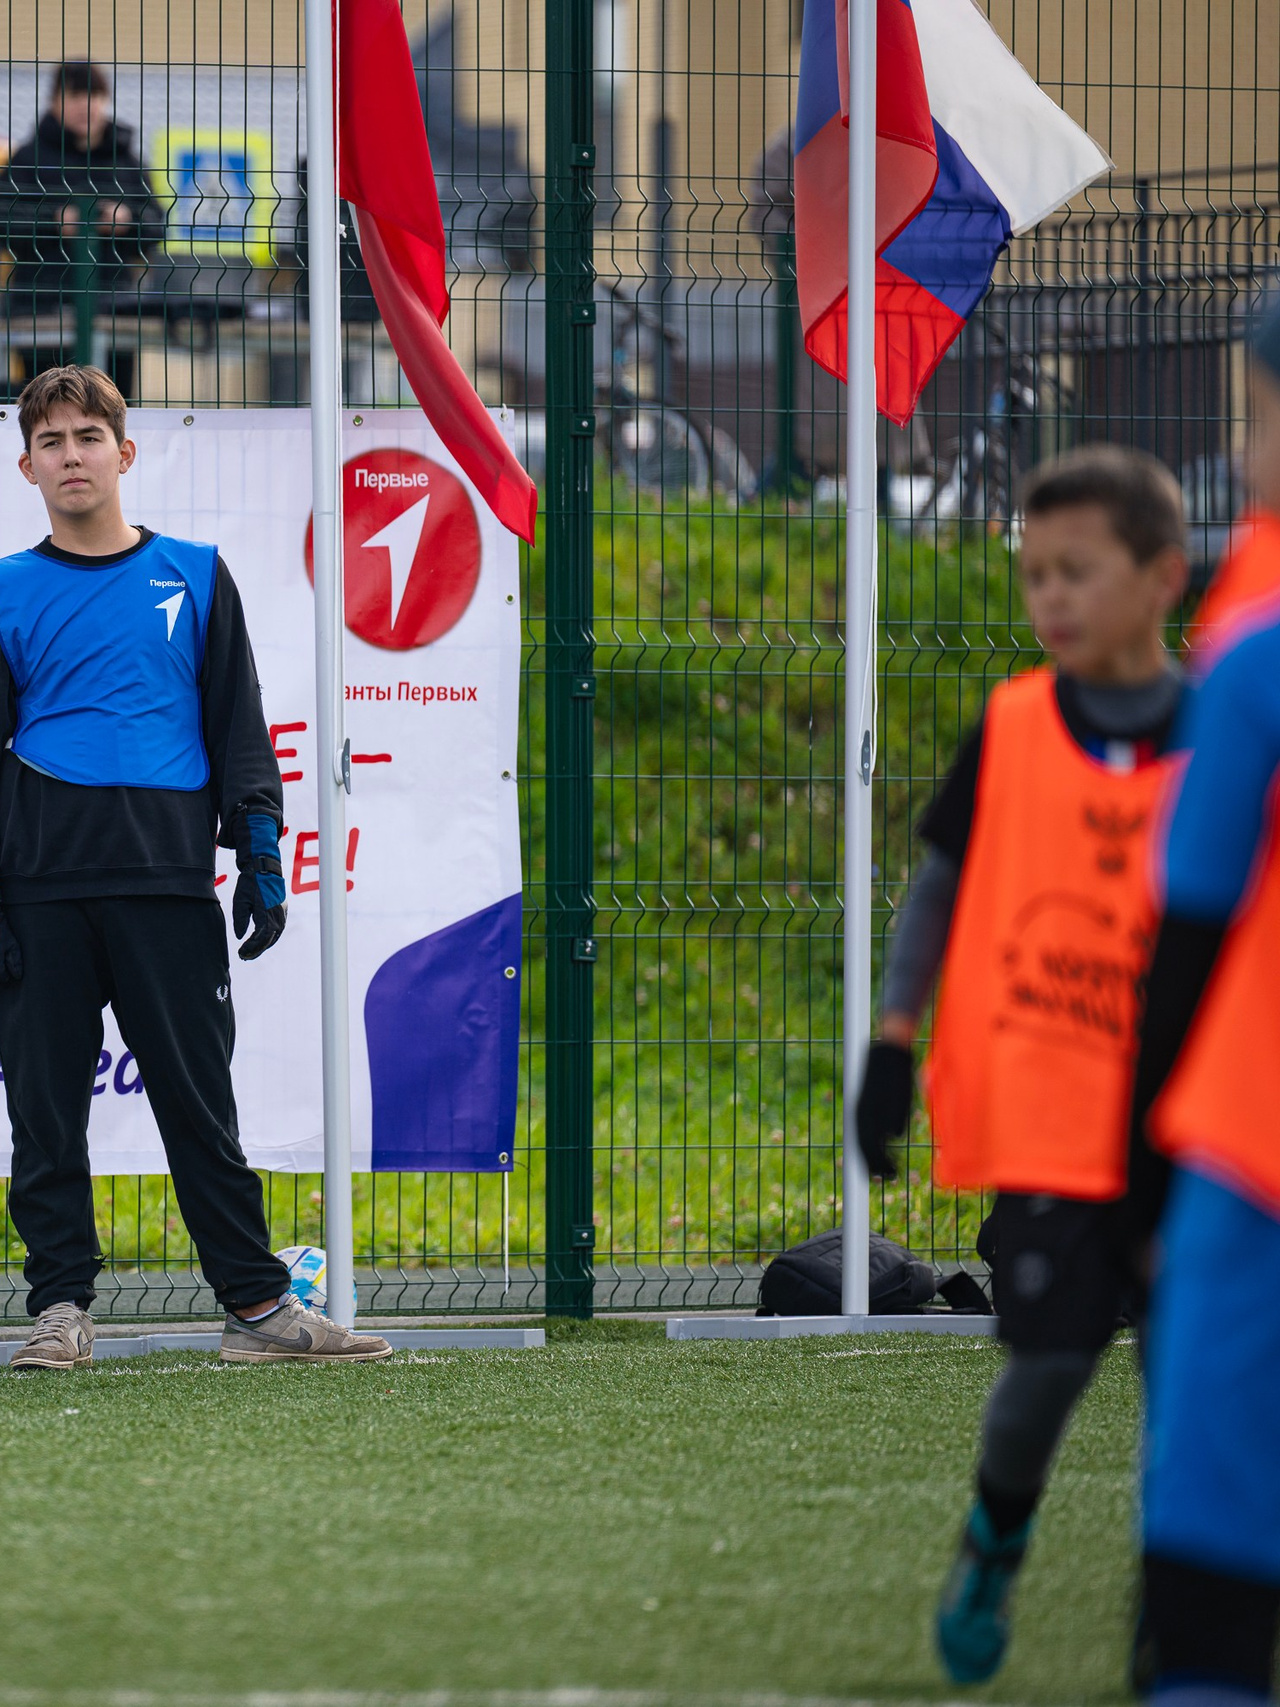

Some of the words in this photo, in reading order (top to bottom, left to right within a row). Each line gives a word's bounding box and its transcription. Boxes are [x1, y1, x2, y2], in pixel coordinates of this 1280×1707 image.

[355, 468, 429, 494] Первые
[149, 579, 186, 589] Первые
[344, 685, 391, 701] анты
[397, 681, 478, 706] Первых
